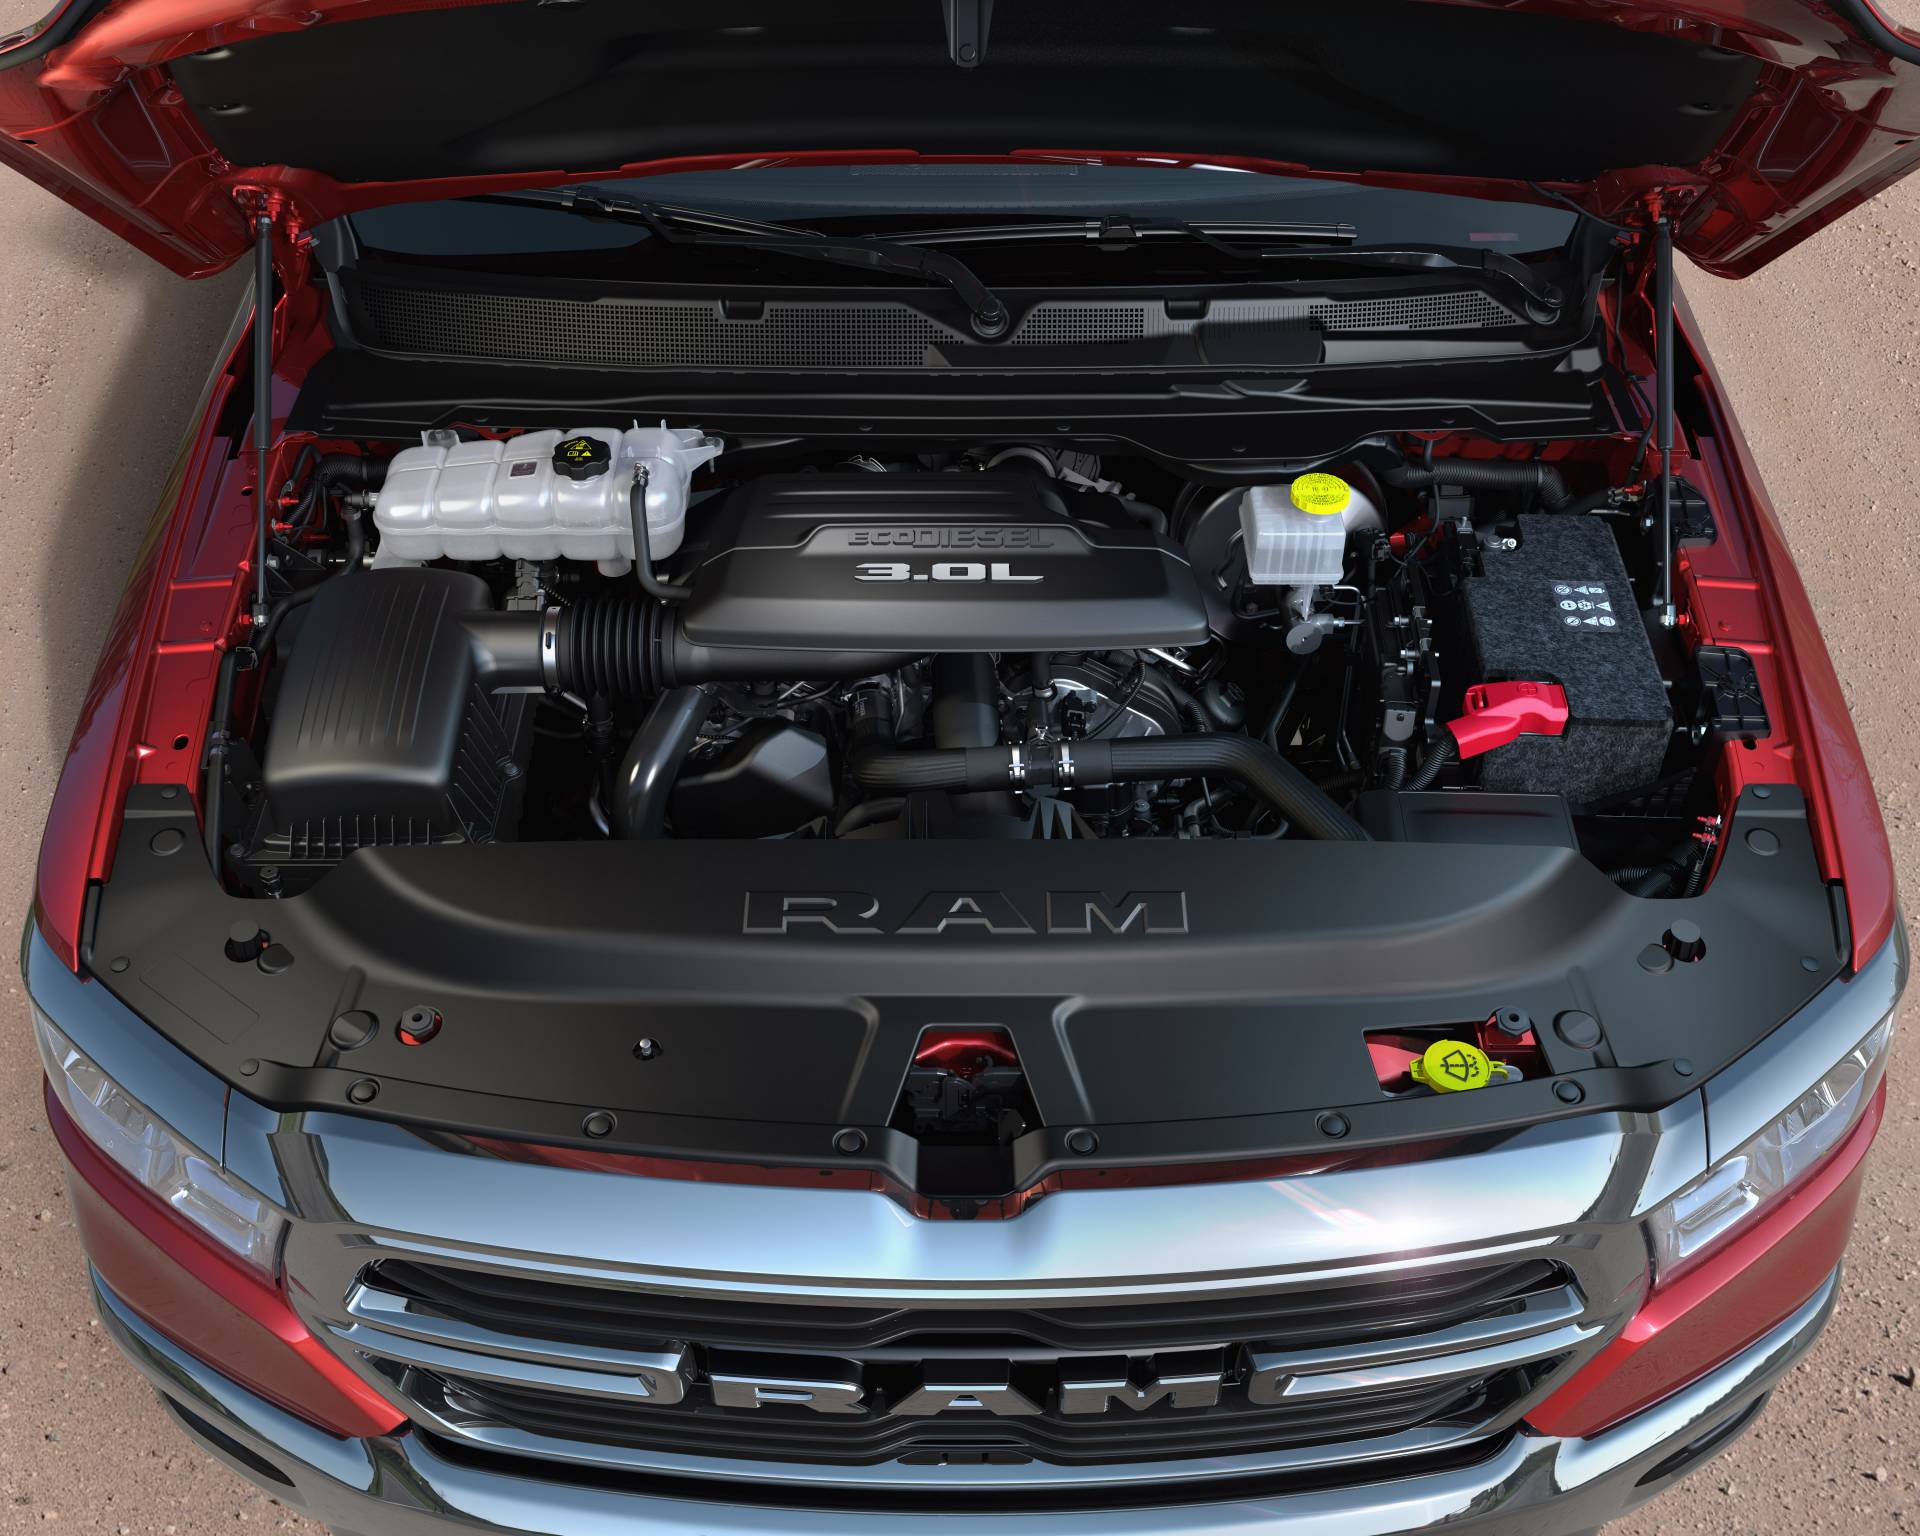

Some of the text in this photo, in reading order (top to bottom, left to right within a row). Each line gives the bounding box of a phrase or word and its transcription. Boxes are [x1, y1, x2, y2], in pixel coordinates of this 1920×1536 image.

[848, 528, 1054, 548] ECODIESEL
[854, 562, 1045, 583] 3.0L
[742, 890, 1190, 934] RAM
[708, 1364, 1222, 1416] RAM
